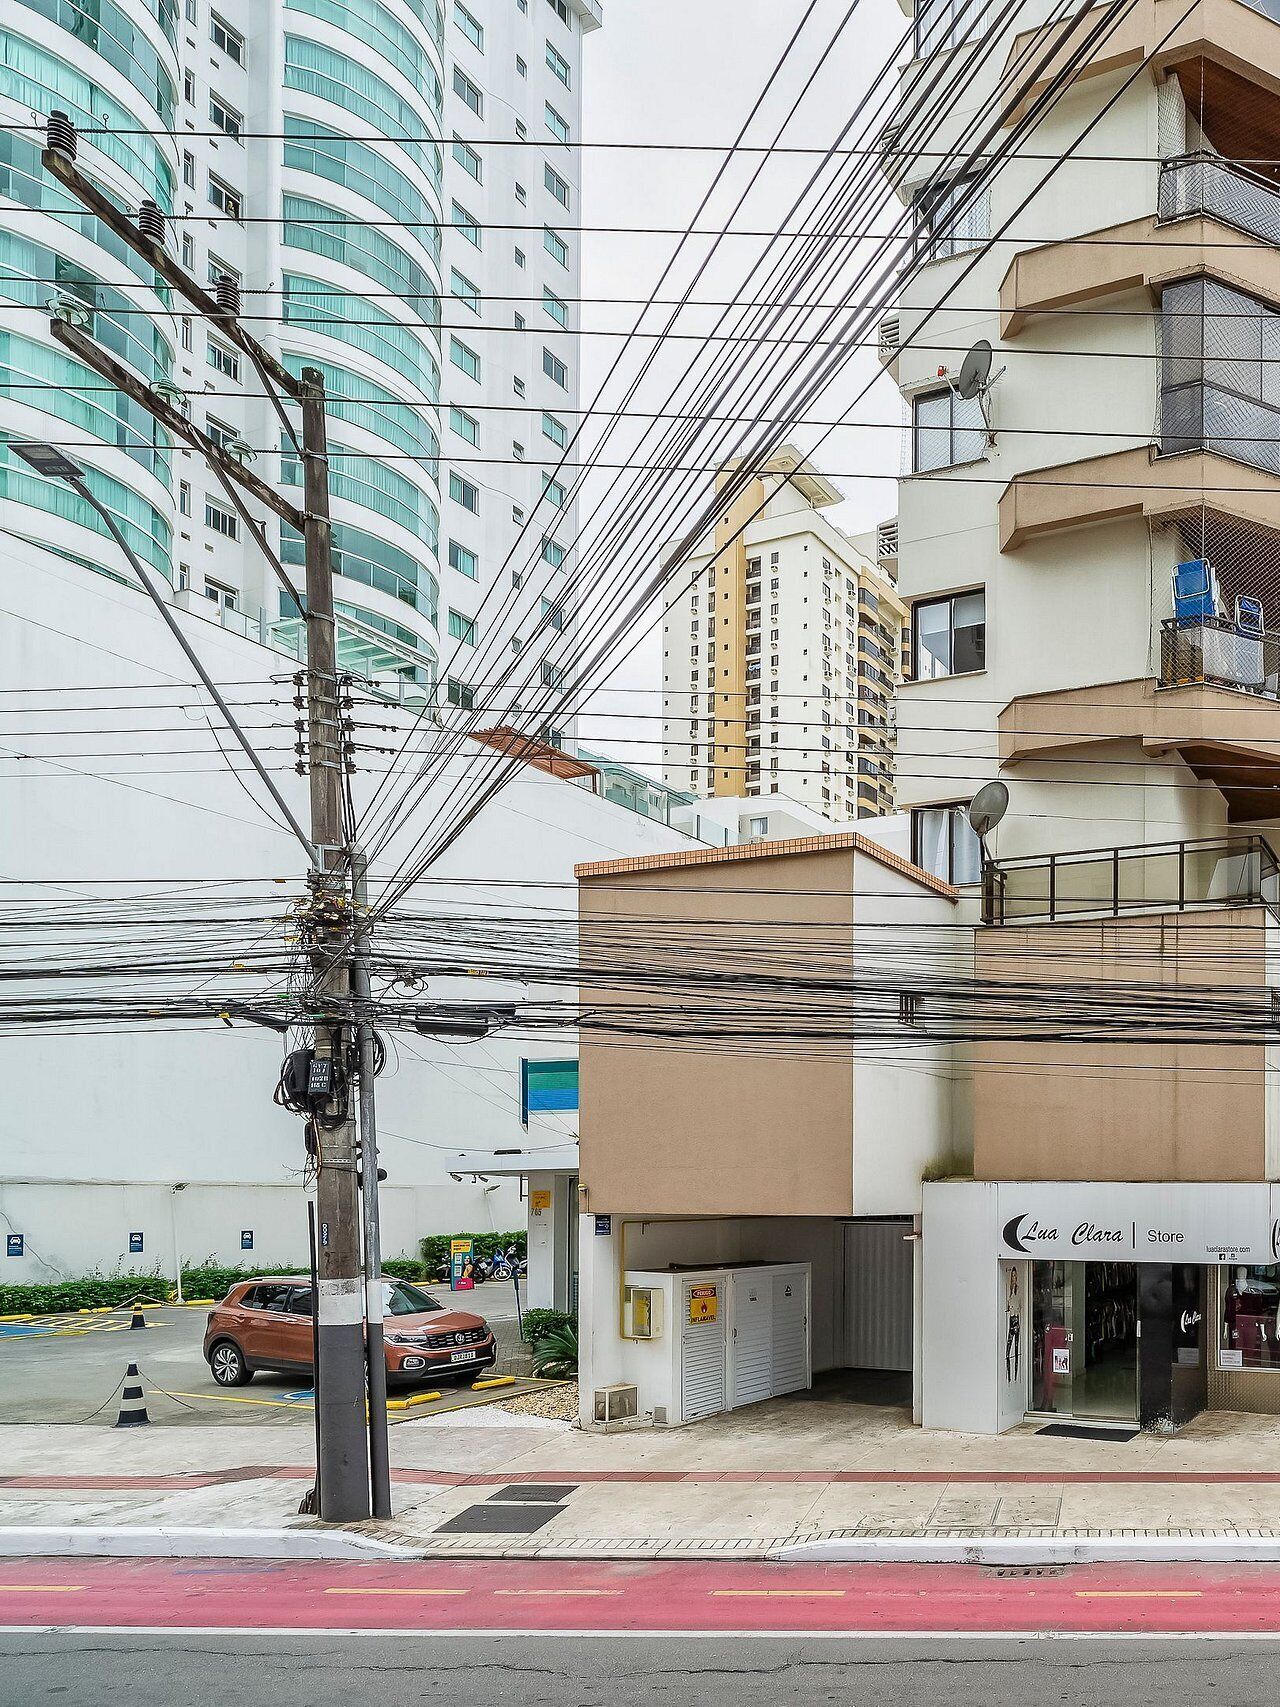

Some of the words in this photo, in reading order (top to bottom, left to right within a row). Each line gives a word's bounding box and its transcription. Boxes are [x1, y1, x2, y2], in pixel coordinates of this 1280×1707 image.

[1021, 1221, 1059, 1241] Lua
[1071, 1221, 1123, 1246] Clara
[1147, 1229, 1184, 1243] Store
